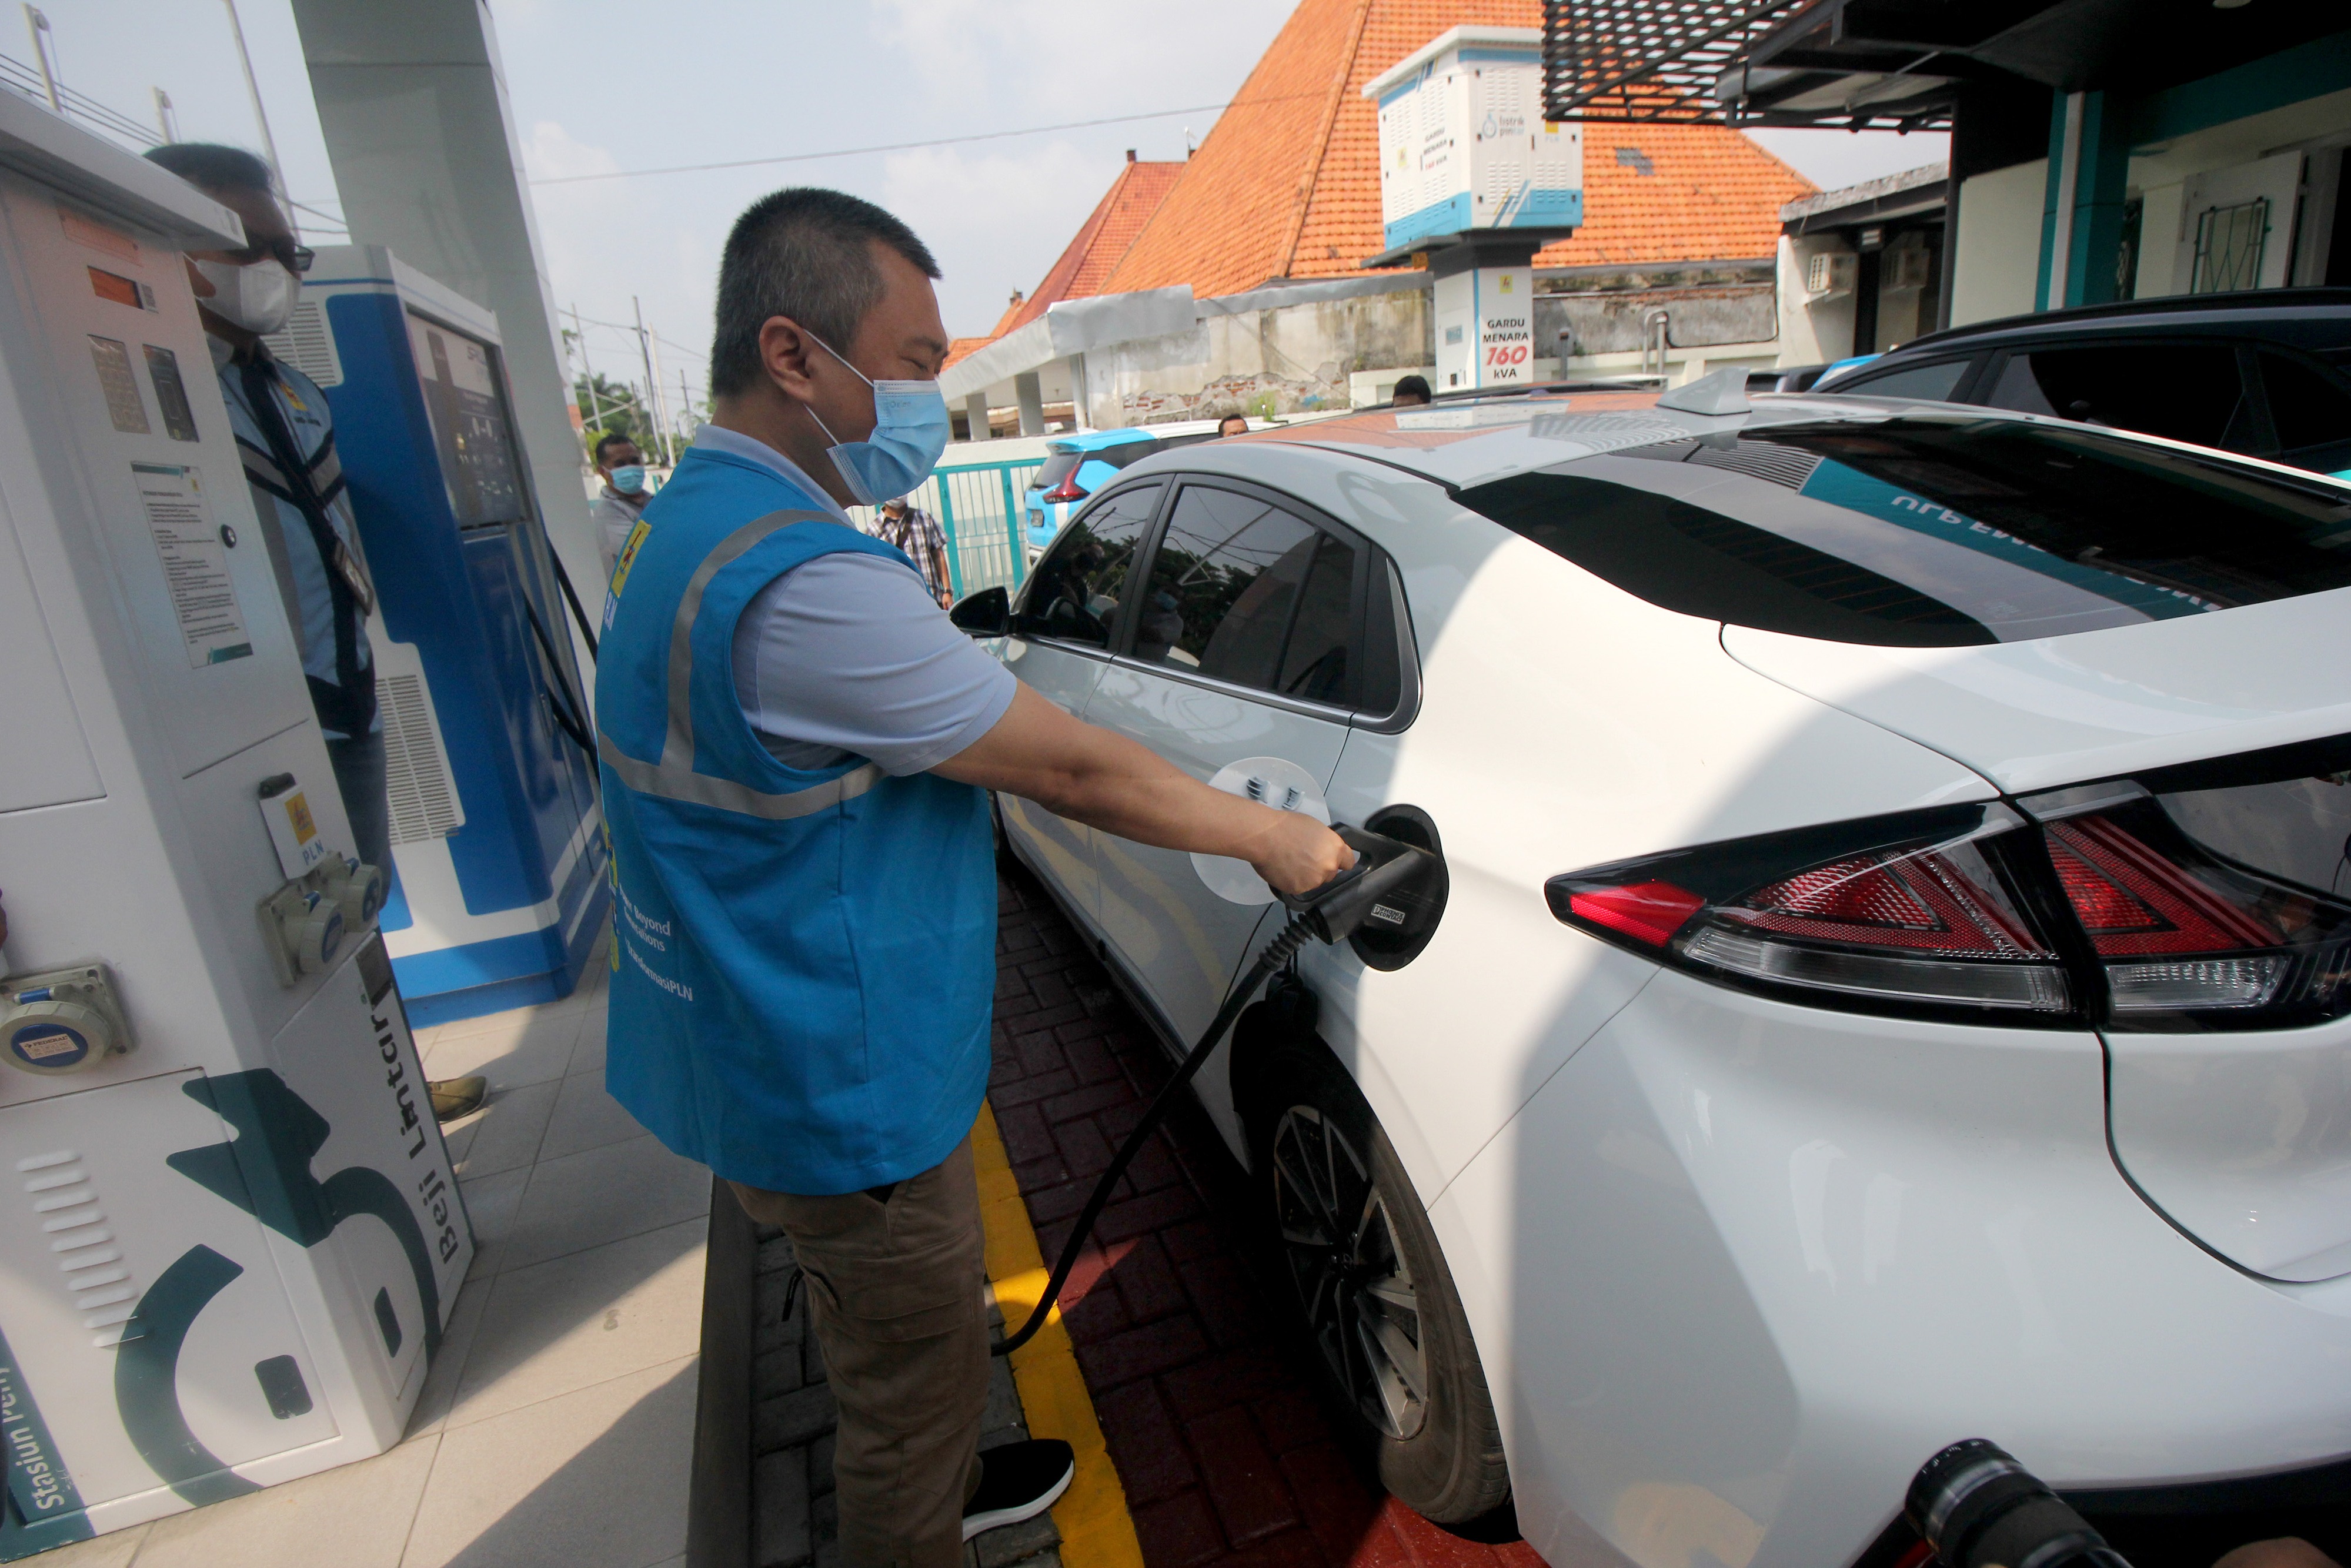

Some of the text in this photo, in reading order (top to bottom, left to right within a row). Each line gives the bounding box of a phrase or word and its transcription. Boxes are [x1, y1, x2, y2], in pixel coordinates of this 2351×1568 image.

[1488, 319, 1525, 329] GARDU
[1483, 332, 1528, 343] MENARA
[1486, 346, 1528, 366] 160
[1494, 368, 1517, 379] kVA
[603, 591, 618, 631] PLN
[302, 840, 324, 866] PLN
[33, 1037, 68, 1047] FEDERAL
[9, 1426, 65, 1510] Stasiun
